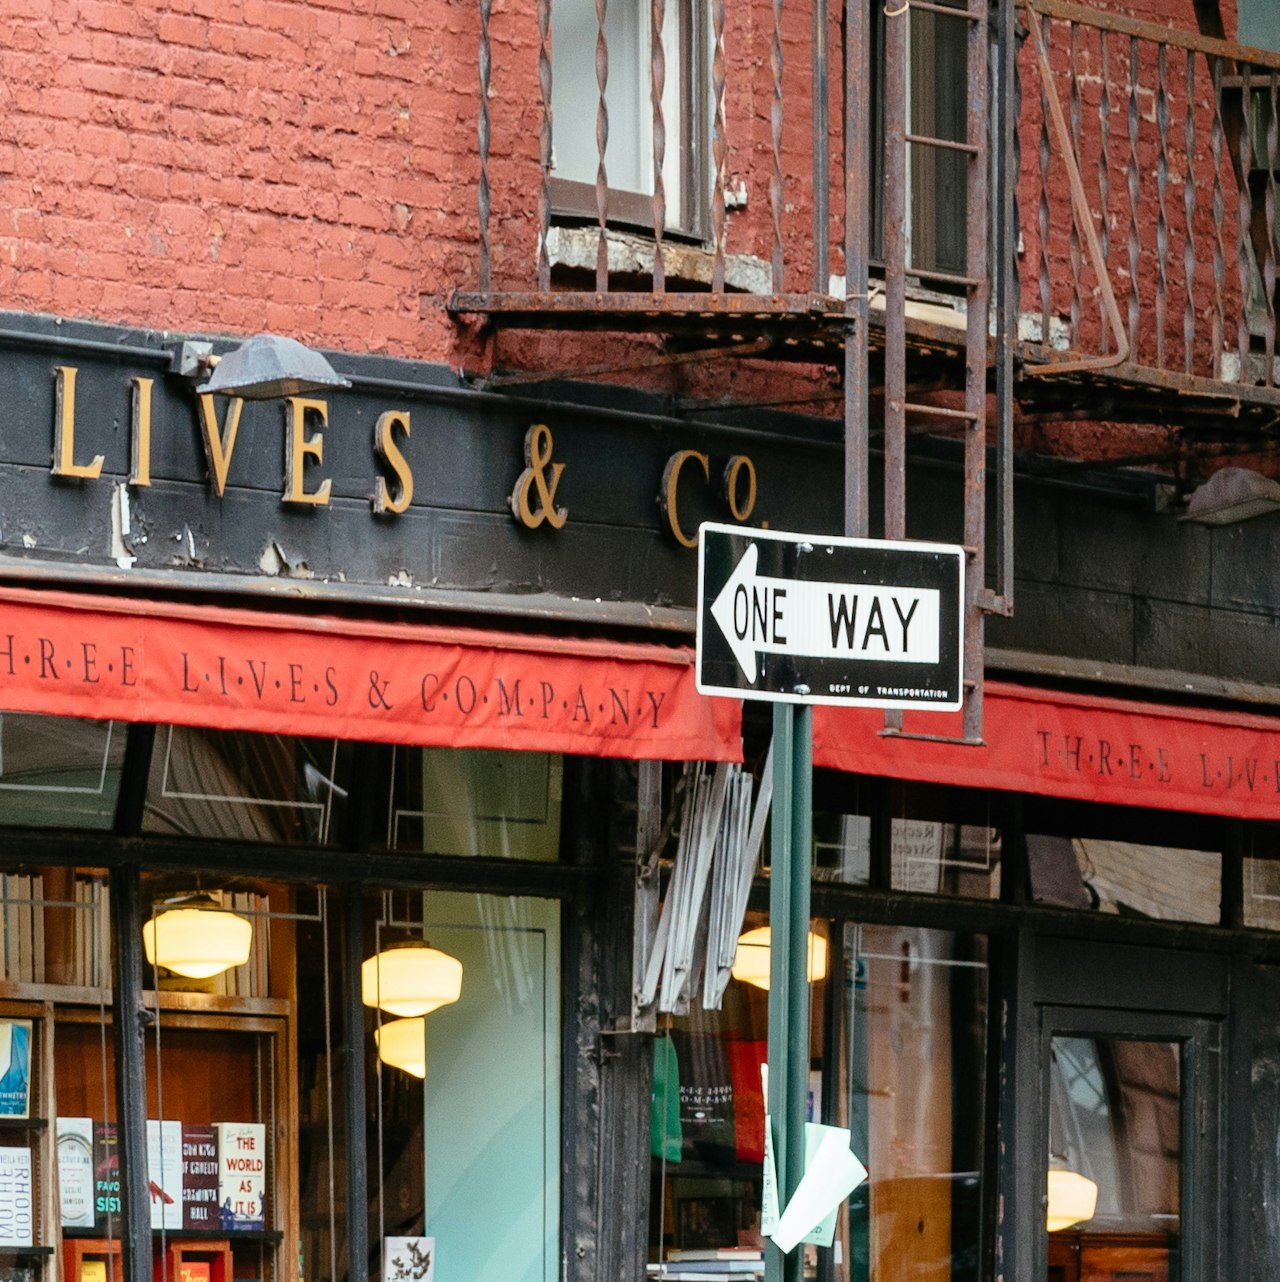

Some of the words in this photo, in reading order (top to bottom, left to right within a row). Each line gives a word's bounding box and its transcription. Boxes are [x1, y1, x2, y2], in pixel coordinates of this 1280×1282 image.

[51, 365, 416, 514] LIVES
[510, 423, 568, 530] &
[733, 582, 788, 646] ONE
[827, 592, 920, 653] WAY
[368, 671, 395, 711] &
[828, 683, 851, 694] DEPT
[858, 685, 870, 695] OF
[877, 686, 948, 699] TRANSPORTATION
[236, 1136, 256, 1150] THE
[226, 1158, 264, 1172] WORLD
[239, 1179, 253, 1193] AS
[190, 1206, 209, 1220] HALL
[235, 1201, 245, 1215] IT
[247, 1201, 256, 1215] IS
